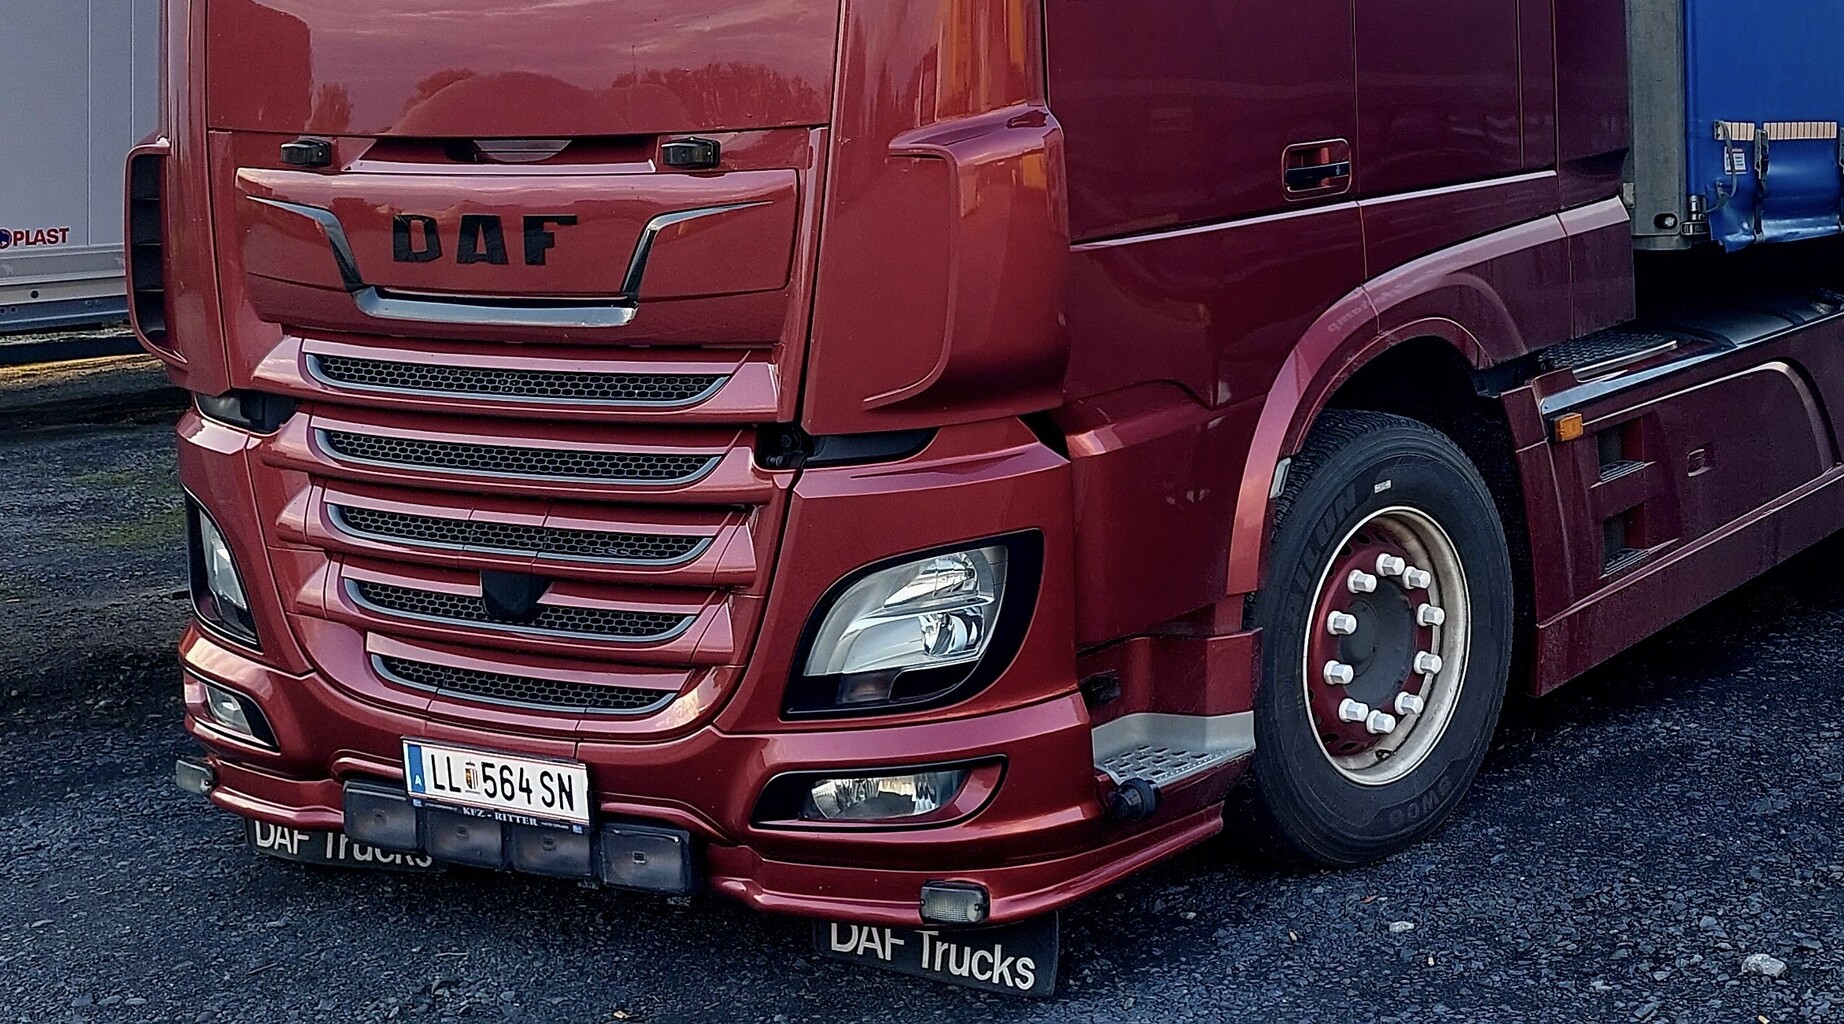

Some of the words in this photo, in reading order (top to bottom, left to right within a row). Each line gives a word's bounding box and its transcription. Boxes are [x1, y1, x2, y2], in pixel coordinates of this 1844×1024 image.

[13, 227, 70, 246] PLAST
[393, 214, 578, 265] DAF
[414, 774, 423, 786] A
[430, 754, 462, 793] LL
[481, 761, 533, 805] 564
[540, 770, 574, 812] SN
[830, 922, 905, 961] DAF
[914, 929, 1037, 991] Trucks
